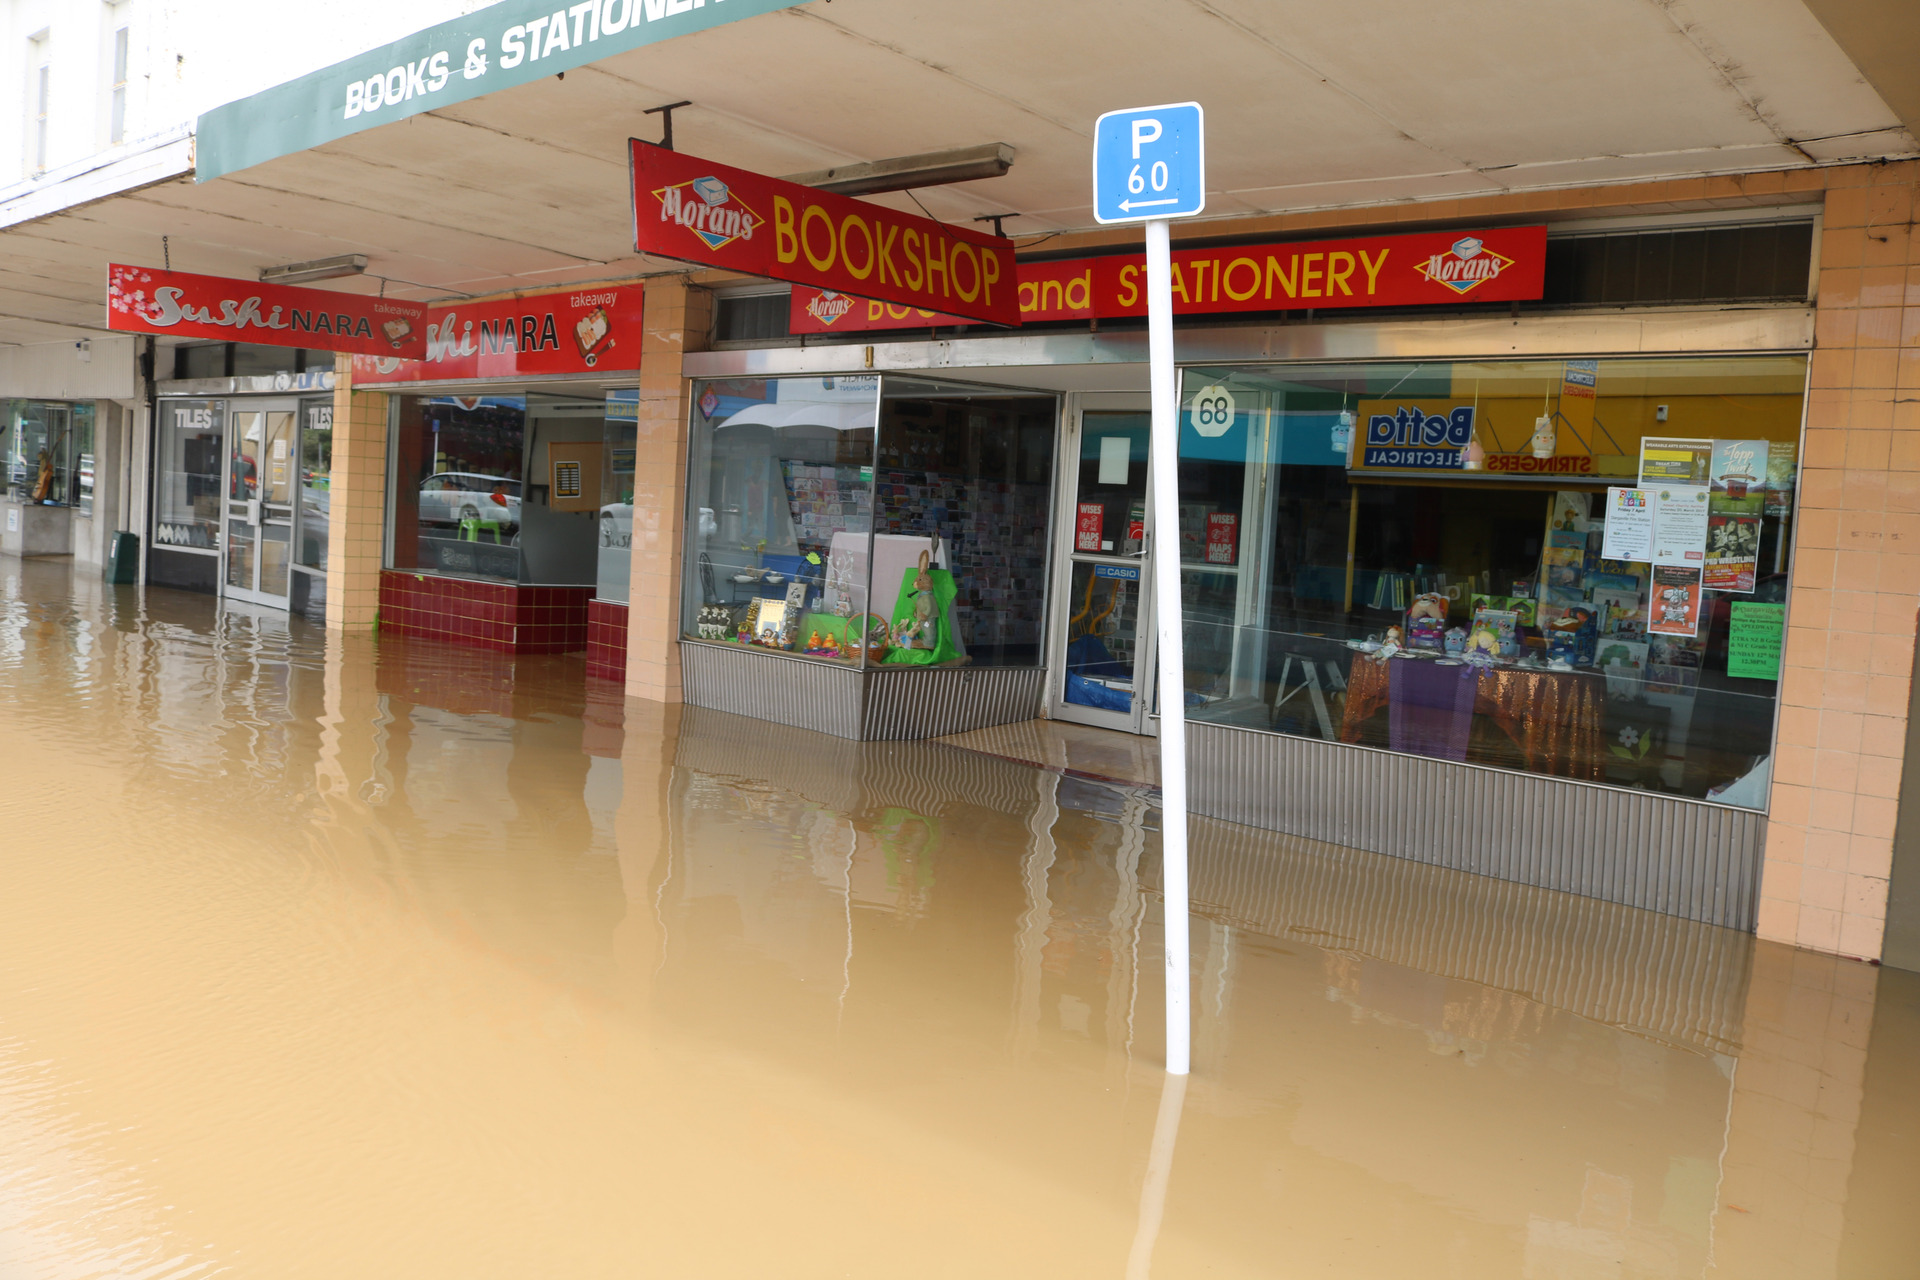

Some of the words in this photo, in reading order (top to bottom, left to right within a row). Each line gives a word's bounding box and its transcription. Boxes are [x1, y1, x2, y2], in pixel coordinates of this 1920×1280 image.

[344, 51, 449, 120] BOOKS
[463, 37, 491, 82] &
[500, 0, 726, 69] STATION
[1132, 118, 1163, 159] P
[1128, 160, 1168, 194] 60
[660, 185, 754, 242] Moran's
[773, 194, 1001, 306] BOOKSHOP
[1425, 254, 1501, 283] Moran's
[1018, 268, 1092, 313] and
[1117, 248, 1390, 307] SATIONERY
[374, 302, 423, 319] takeaway
[570, 291, 617, 309] takeaway
[808, 297, 850, 316] Moran's
[142, 286, 289, 330] Sushi
[290, 308, 374, 339] NARA
[481, 313, 560, 355] NARA
[175, 408, 212, 429] TILES
[309, 407, 332, 430] TILES
[1200, 396, 1227, 425] 68
[1726, 441, 1754, 464] Topp
[1080, 505, 1101, 515] WISES
[1211, 514, 1235, 524] WISES
[1078, 541, 1098, 550] HERE!
[1079, 532, 1099, 542] MAPS
[1209, 543, 1232, 553] MAPS
[1209, 552, 1231, 562] HERE!
[1107, 568, 1136, 578] CASIO
